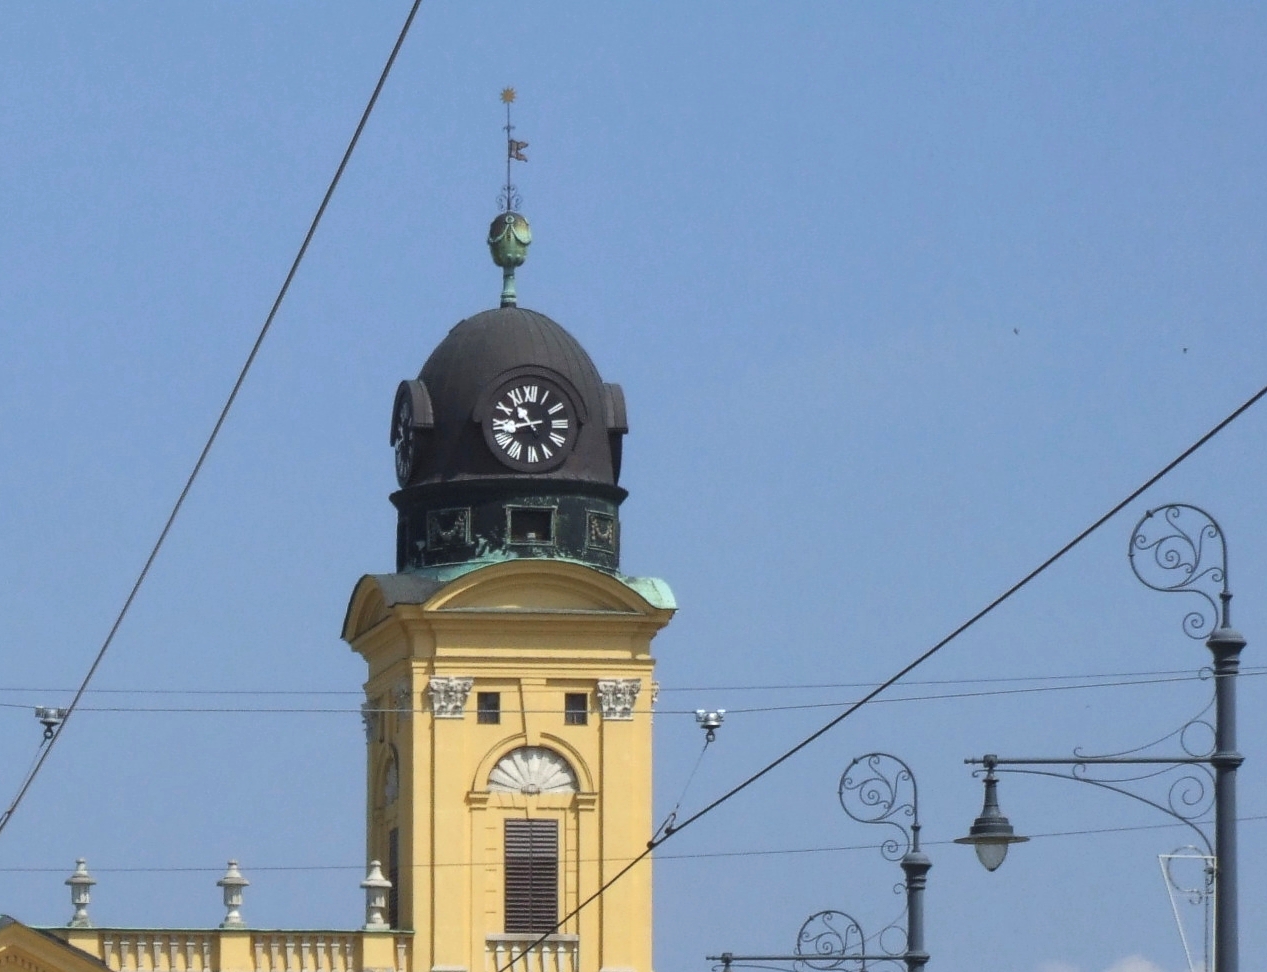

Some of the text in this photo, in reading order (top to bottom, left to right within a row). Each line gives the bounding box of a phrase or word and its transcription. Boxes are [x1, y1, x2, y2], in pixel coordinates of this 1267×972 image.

[507, 388, 523, 407] XI
[523, 386, 537, 402] XII
[496, 401, 513, 416] X
[528, 446, 539, 462] VI
[541, 443, 553, 459] V
